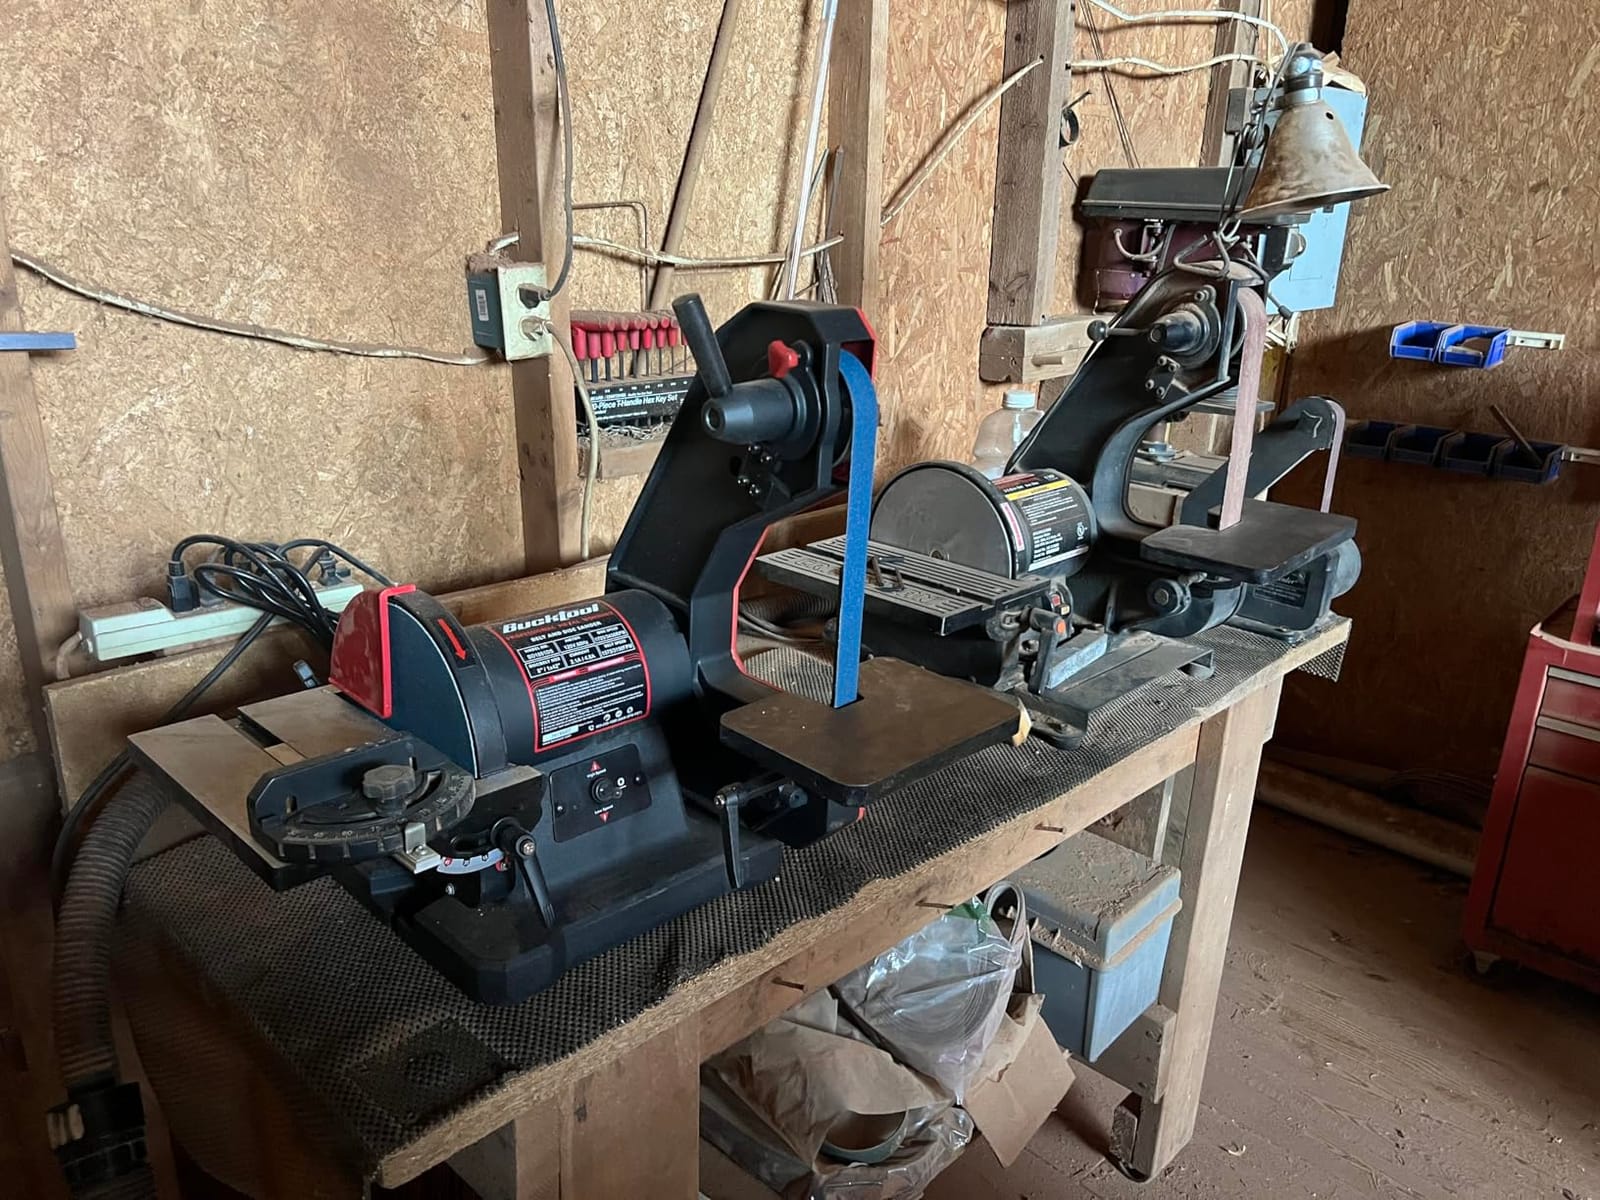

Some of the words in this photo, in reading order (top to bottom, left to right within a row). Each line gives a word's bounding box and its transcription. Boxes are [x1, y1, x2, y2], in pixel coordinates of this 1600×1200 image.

[617, 398, 643, 408] T-Handle
[643, 396, 655, 405] Hex
[655, 394, 666, 404] Key
[667, 393, 678, 402] Set
[530, 634, 546, 643] BELT
[547, 630, 562, 639] AND
[563, 626, 577, 635] DISC
[578, 621, 602, 631] SANDER
